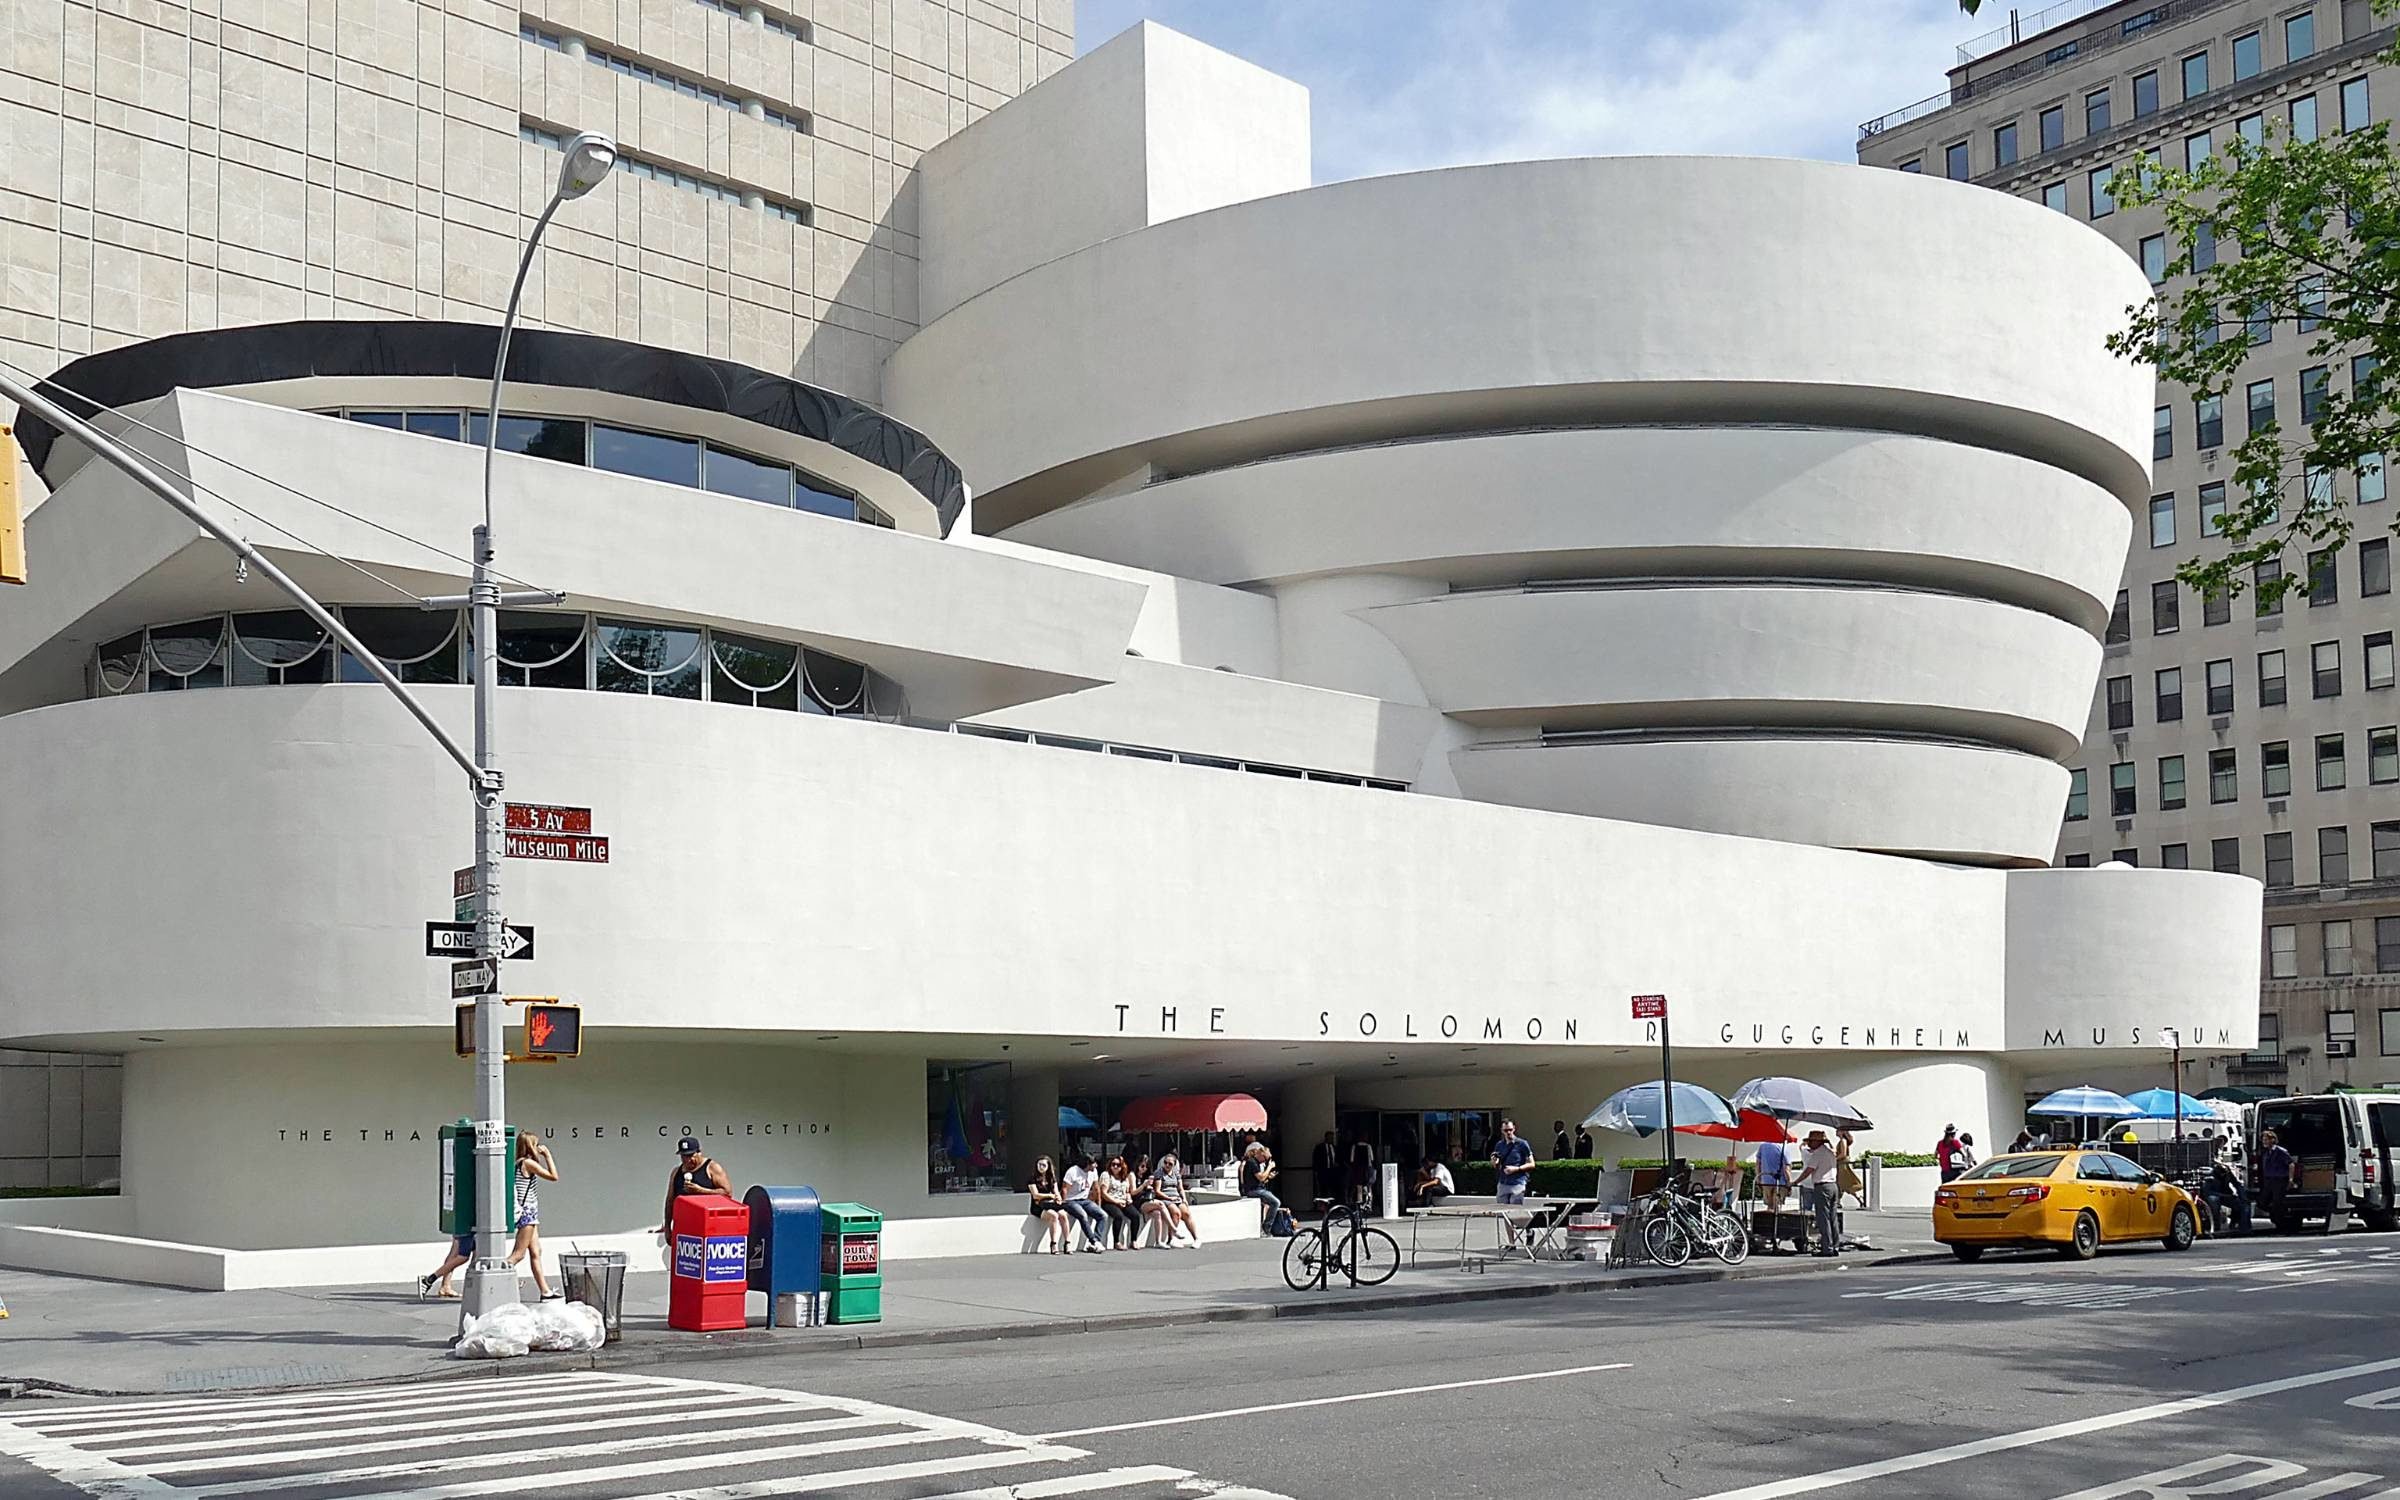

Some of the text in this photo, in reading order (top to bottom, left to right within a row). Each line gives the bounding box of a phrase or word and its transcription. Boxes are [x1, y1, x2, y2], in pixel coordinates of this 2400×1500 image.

[530, 808, 564, 830] 5 Av
[506, 837, 606, 860] Museum Mile
[441, 932, 473, 947] ONE
[457, 969, 491, 986] ONE WAY
[1114, 1004, 1225, 1033] THE
[1319, 1011, 1577, 1040] SOLOMON
[1720, 1023, 1969, 1047] GUGGENHEIM
[2043, 1027, 2229, 1046] MUSUM
[278, 1129, 332, 1141] THE
[658, 1123, 830, 1138] COLLECTION
[934, 1166, 956, 1174] CRAFT
[679, 1240, 702, 1260] VOICE
[709, 1242, 745, 1260] VOICE
[844, 1246, 865, 1254] OUR
